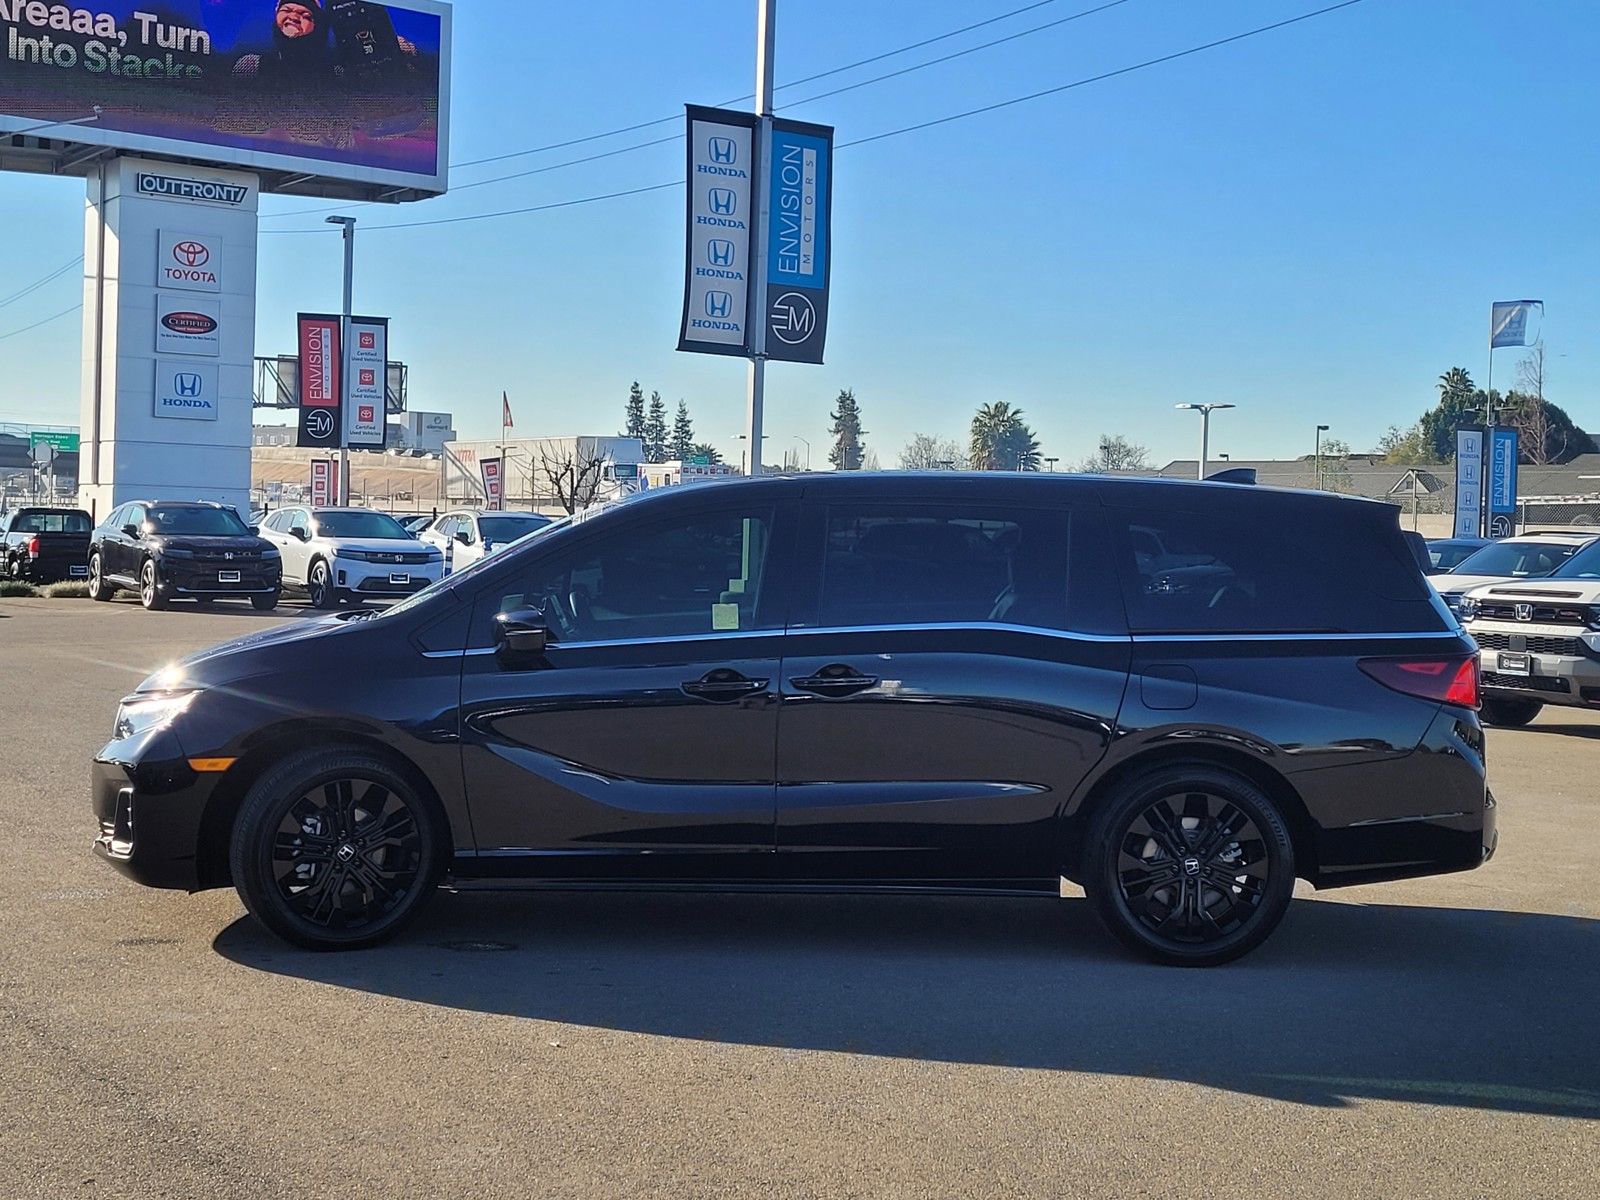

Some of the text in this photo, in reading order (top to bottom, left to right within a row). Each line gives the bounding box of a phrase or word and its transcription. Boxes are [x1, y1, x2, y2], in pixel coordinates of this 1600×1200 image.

[8, 26, 78, 68] Into
[134, 11, 210, 55] Turn
[697, 164, 747, 179] HONDA
[696, 215, 746, 230] HONDA
[778, 144, 801, 274] ENVISION
[803, 160, 815, 265] MOTORS
[164, 268, 216, 283] TOYOTA
[695, 266, 744, 281] HONDA
[692, 318, 741, 332] HONDA
[308, 327, 322, 400] ENVISION
[162, 398, 212, 409] HONDA
[1493, 438, 1505, 506] ENVISION
